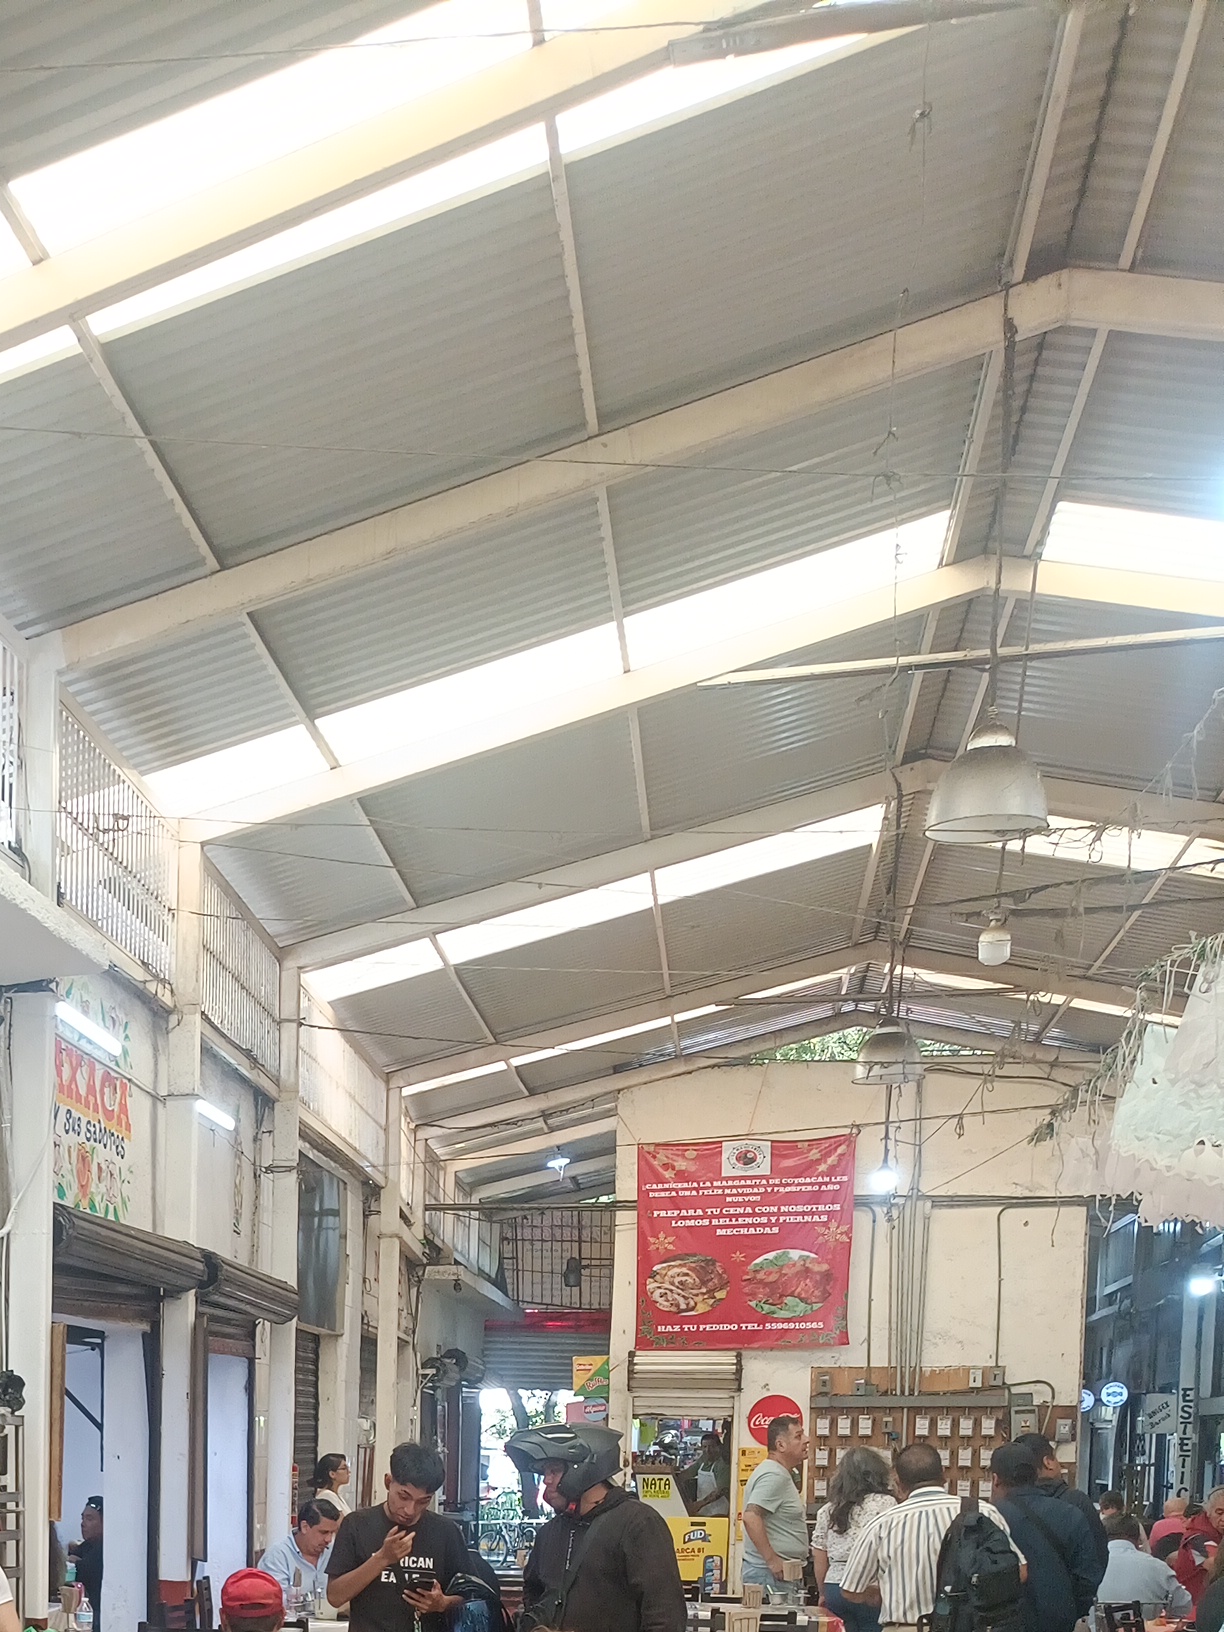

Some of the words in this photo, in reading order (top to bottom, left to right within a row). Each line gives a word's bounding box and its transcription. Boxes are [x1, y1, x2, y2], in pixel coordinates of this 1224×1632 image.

[55, 1038, 131, 1141] AXACA
[713, 1179, 767, 1187] MARGARITA
[724, 1187, 765, 1195] NAVIDAD
[705, 1208, 721, 1216] TU
[722, 1207, 753, 1215] CENA
[780, 1204, 841, 1213] NOSOTROS
[671, 1218, 710, 1227] LOMOS
[711, 1216, 768, 1226] RELLENOS
[769, 1216, 778, 1224] Y
[779, 1215, 828, 1223] PIERNAS
[716, 1227, 779, 1236] MECHADAS
[699, 1323, 738, 1331] PEDIDO
[740, 1323, 762, 1331] TEL:
[1177, 1387, 1195, 1498] ESTETIC
[642, 1477, 671, 1490] NATA
[685, 1530, 705, 1543] FUD
